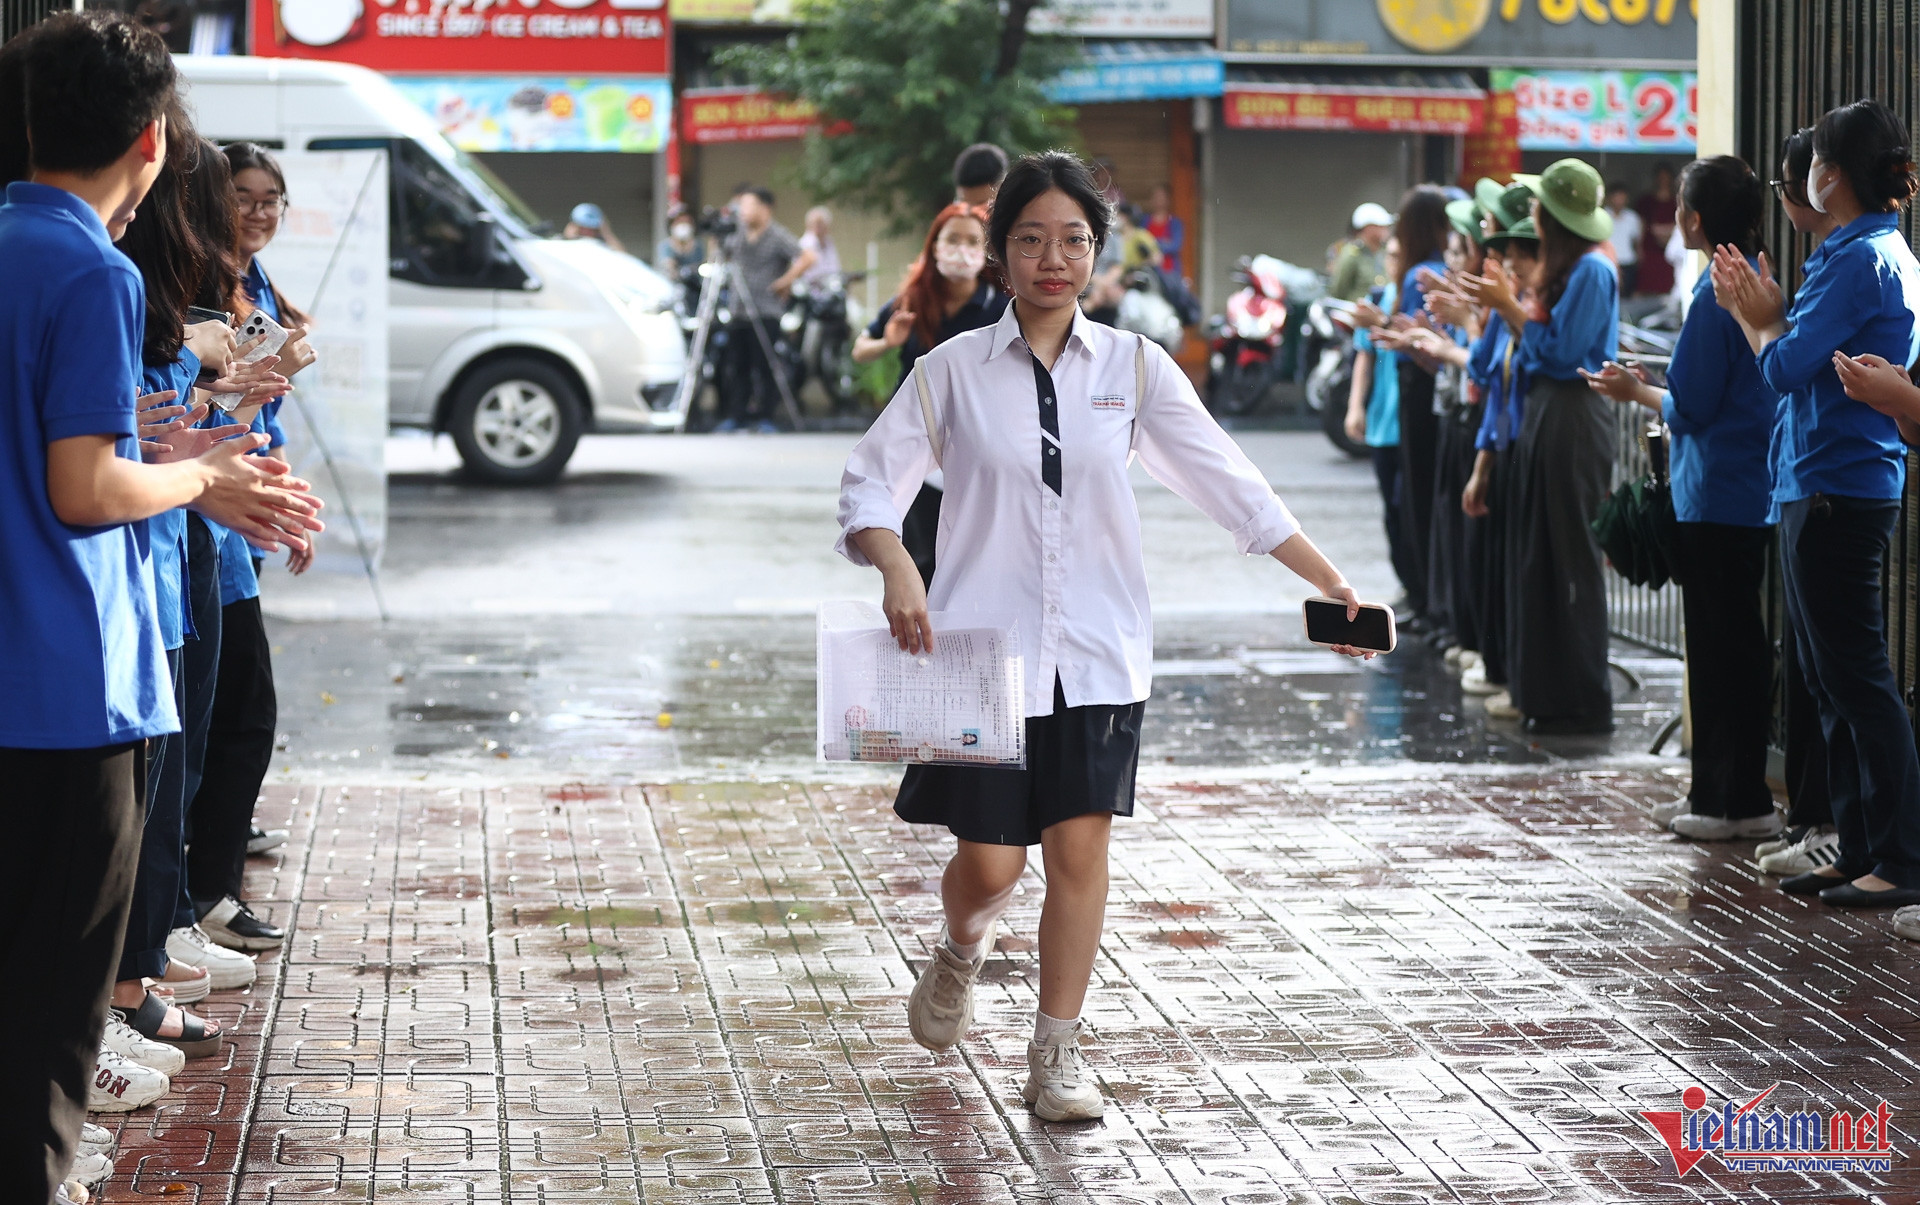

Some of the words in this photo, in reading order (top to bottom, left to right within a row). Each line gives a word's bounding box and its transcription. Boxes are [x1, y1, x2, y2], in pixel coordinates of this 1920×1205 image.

[376, 13, 440, 37] SINCE
[490, 14, 526, 38] ICE
[527, 15, 600, 39] CREAM
[601, 15, 620, 39] &
[621, 15, 664, 39] TEA
[1515, 78, 1590, 109] Size
[1606, 82, 1626, 111] L
[95, 1064, 131, 1099] ON
